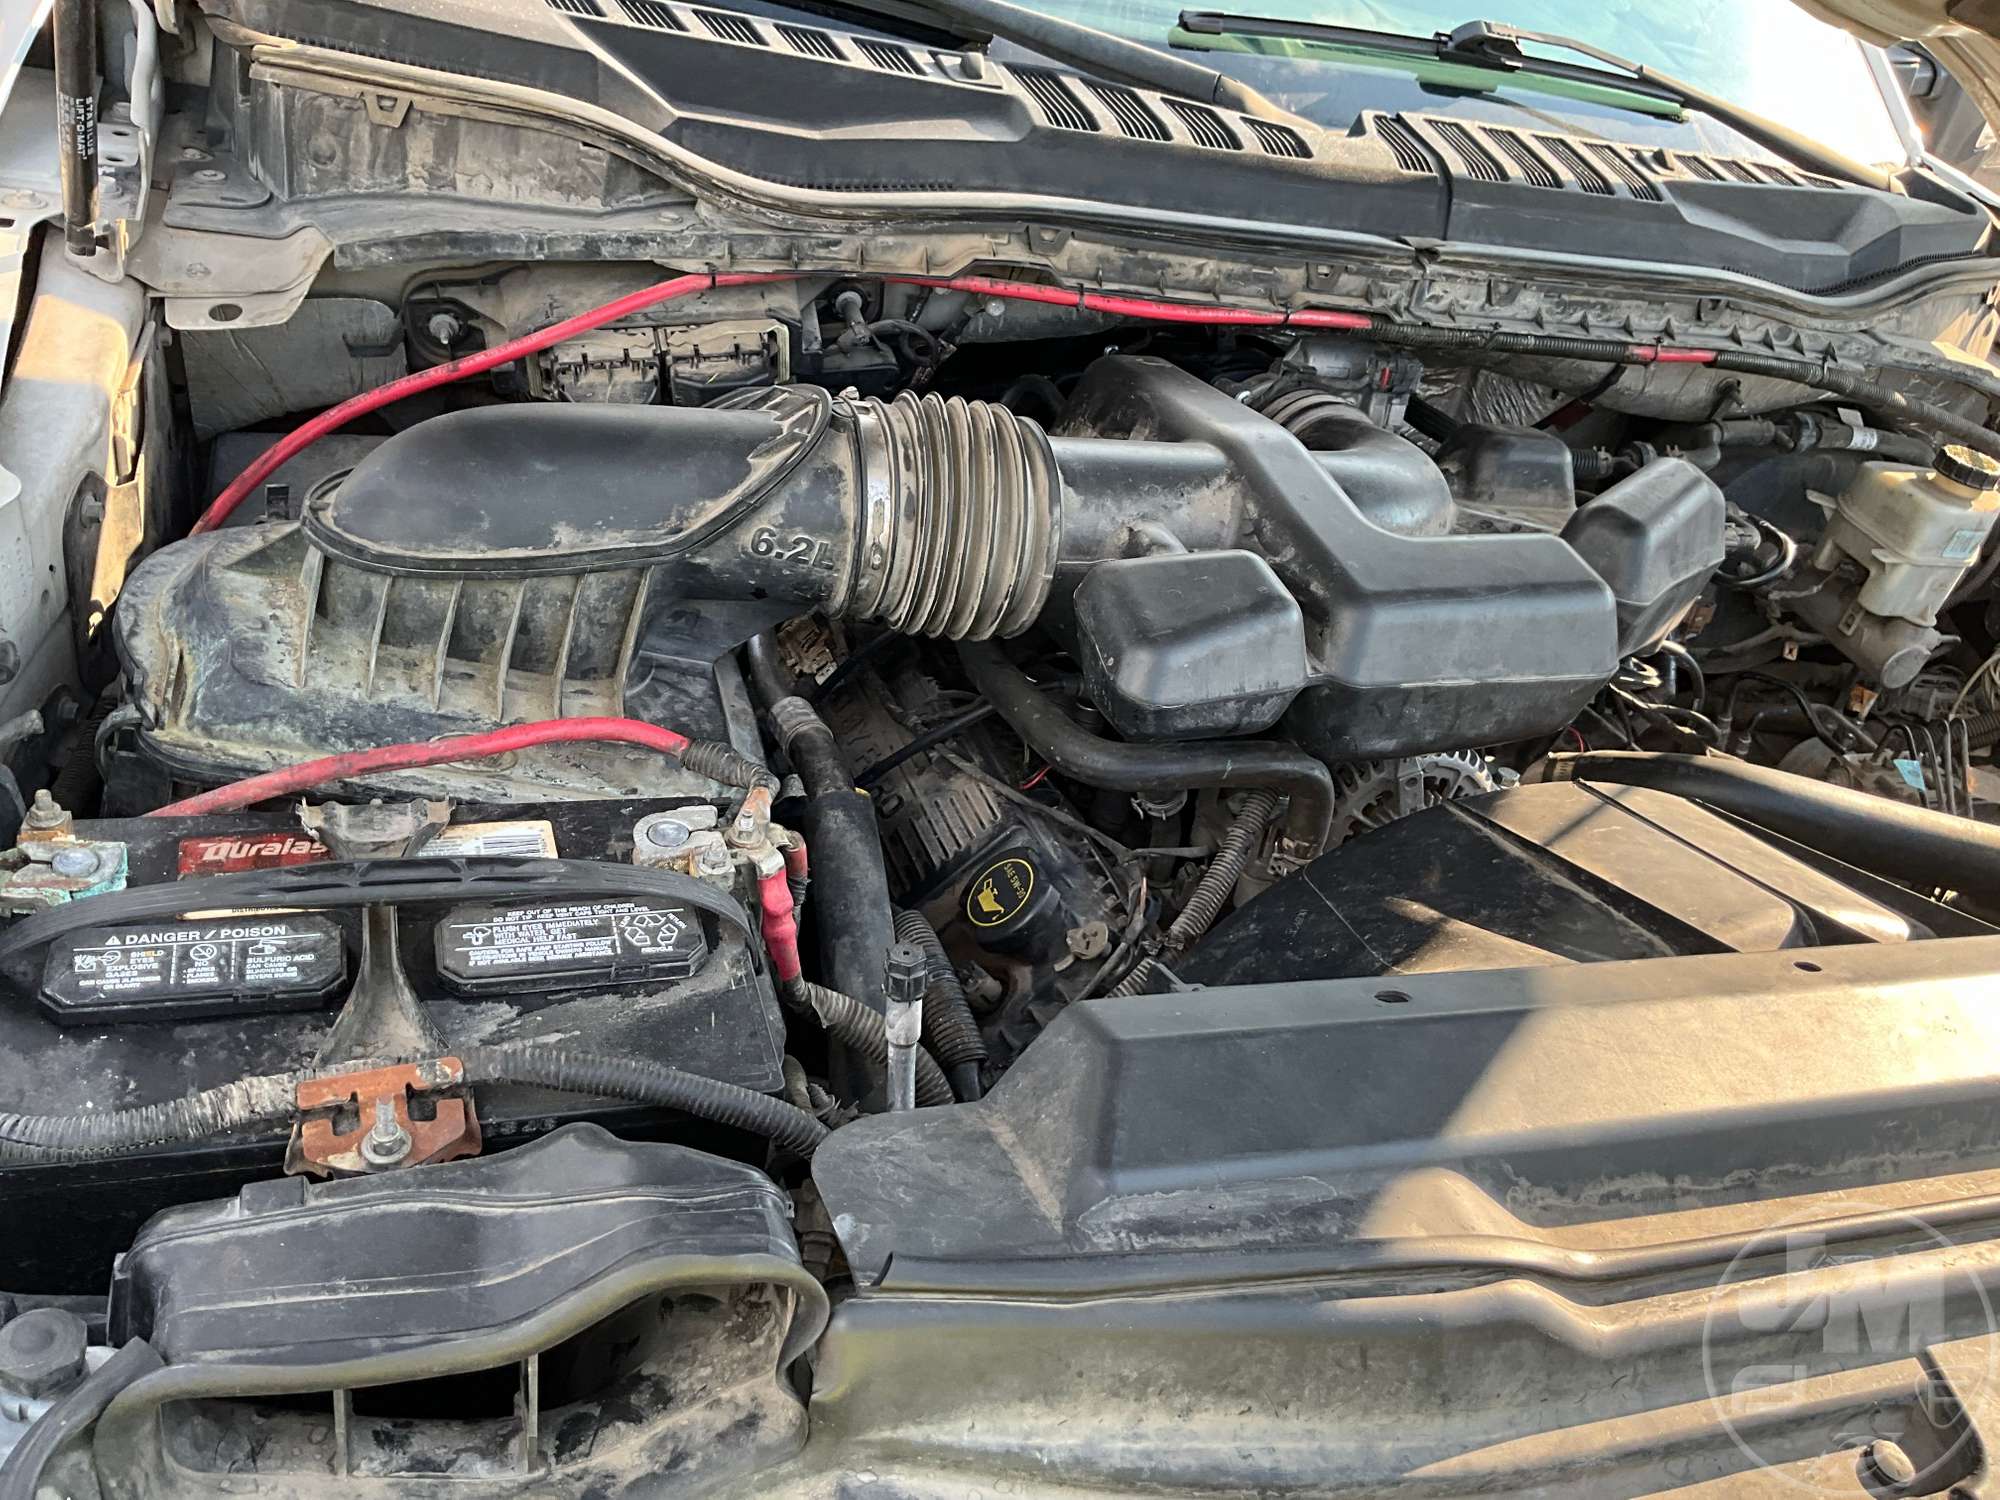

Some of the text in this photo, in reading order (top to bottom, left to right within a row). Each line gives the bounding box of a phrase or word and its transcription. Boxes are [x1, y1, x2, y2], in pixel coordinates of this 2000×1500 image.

[85, 96, 96, 156] STABILUS
[750, 526, 835, 571] 6.2L
[198, 838, 329, 861] Duralas
[1003, 863, 1016, 879] SAE
[493, 915, 504, 923] DO
[505, 914, 519, 922] NOT
[493, 918, 600, 933] FLUSH EYES IMMEDIATELY
[125, 925, 286, 945] DANGER / POISON
[494, 932, 515, 940] WITH
[494, 933, 578, 946] MEDICAL HELP FAST
[130, 950, 164, 958] SHIELD
[641, 945, 673, 953] RECYCLE
[129, 957, 155, 965] EYES
[246, 954, 315, 964] SULFURIC ACID
[106, 963, 159, 972] EXPLOSIVE
[105, 970, 138, 978] GASES
